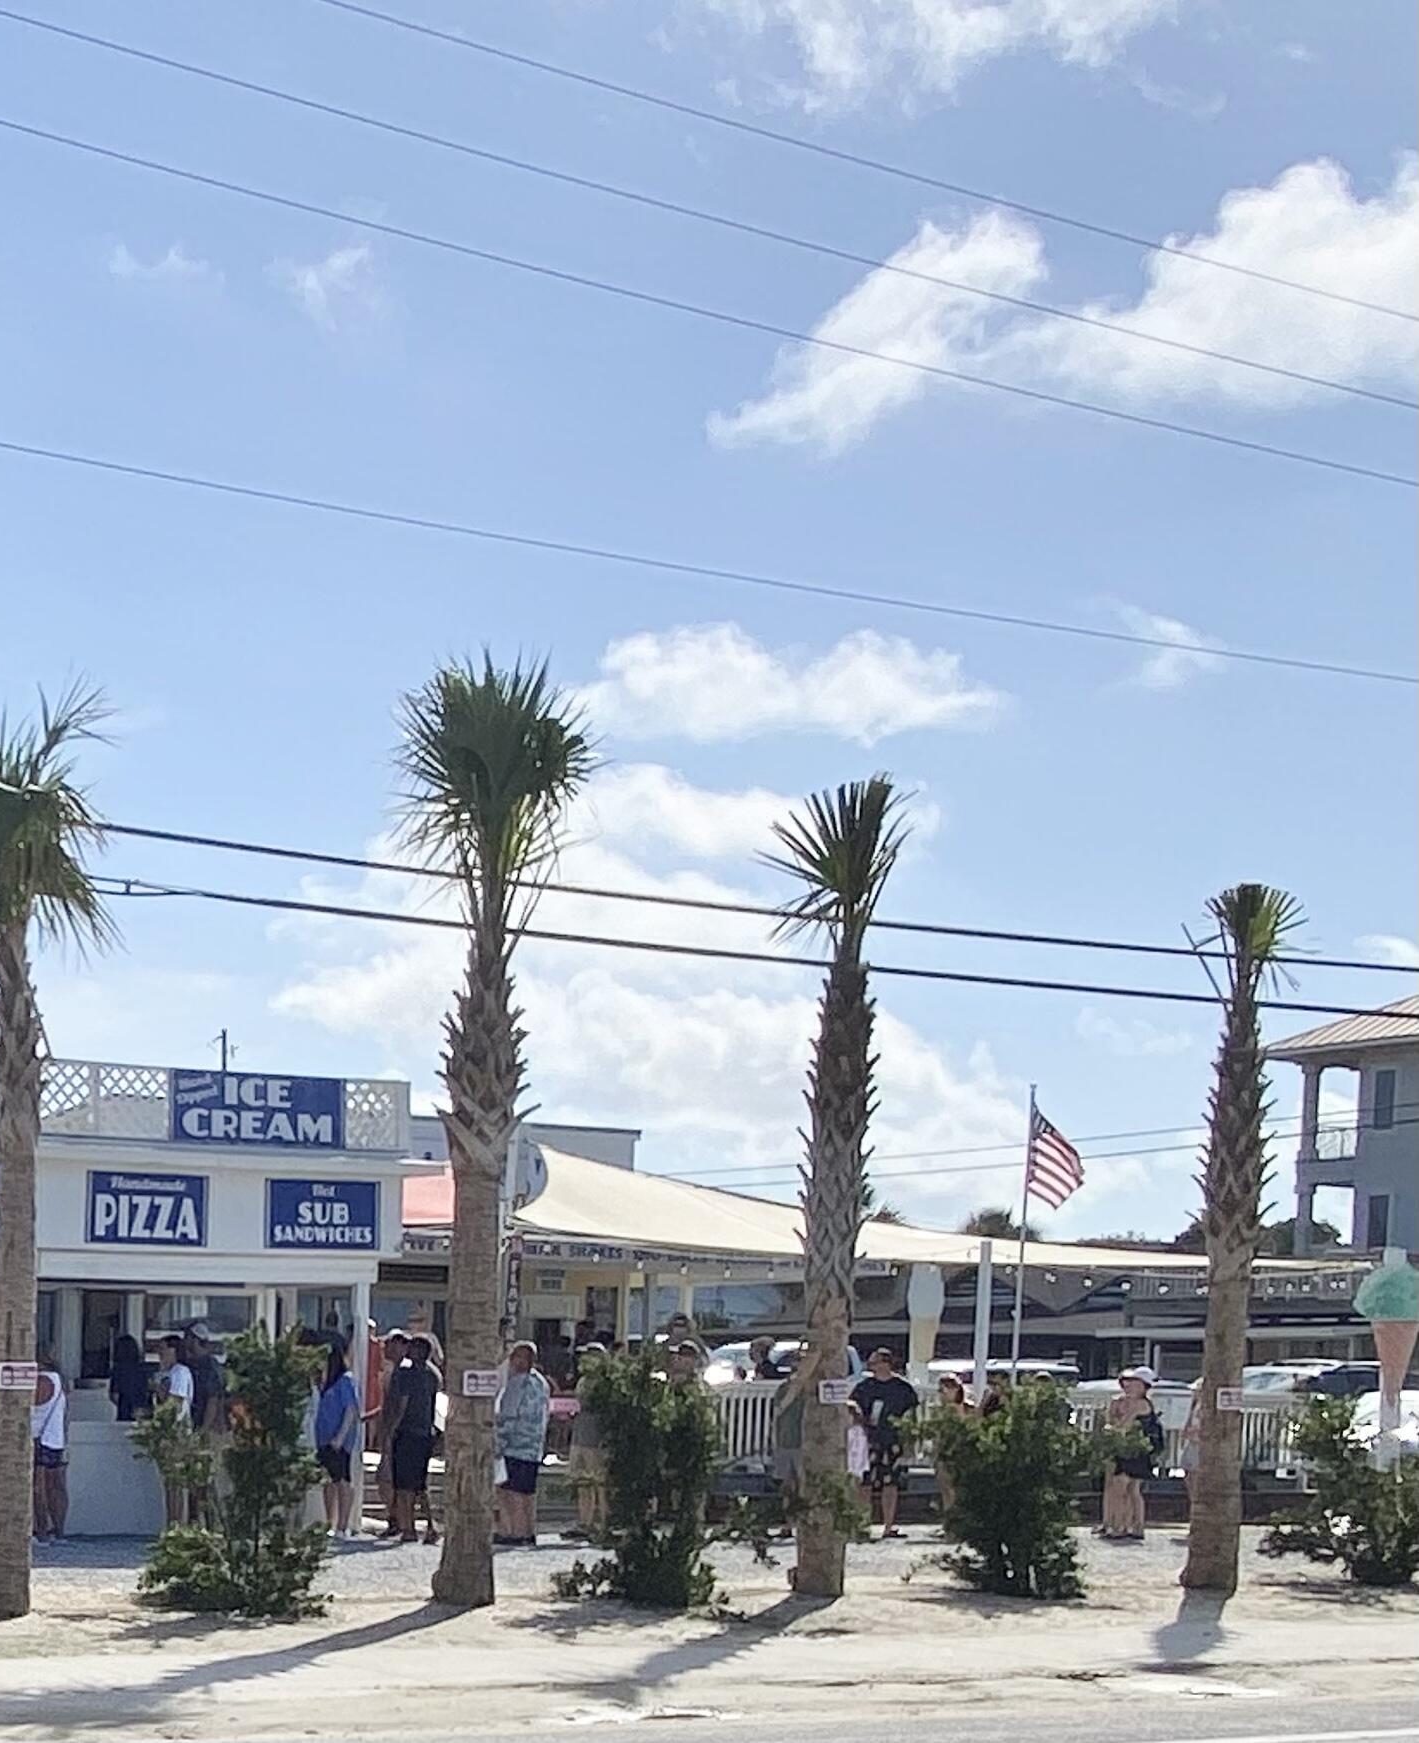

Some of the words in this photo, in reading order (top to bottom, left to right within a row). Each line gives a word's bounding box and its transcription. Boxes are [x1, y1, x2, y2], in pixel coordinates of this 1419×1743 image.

[223, 1076, 292, 1108] ICE
[183, 1107, 332, 1143] CREAM
[94, 1193, 199, 1240] PIZZA
[297, 1201, 350, 1225] SUB
[274, 1224, 372, 1243] SANDWICHES
